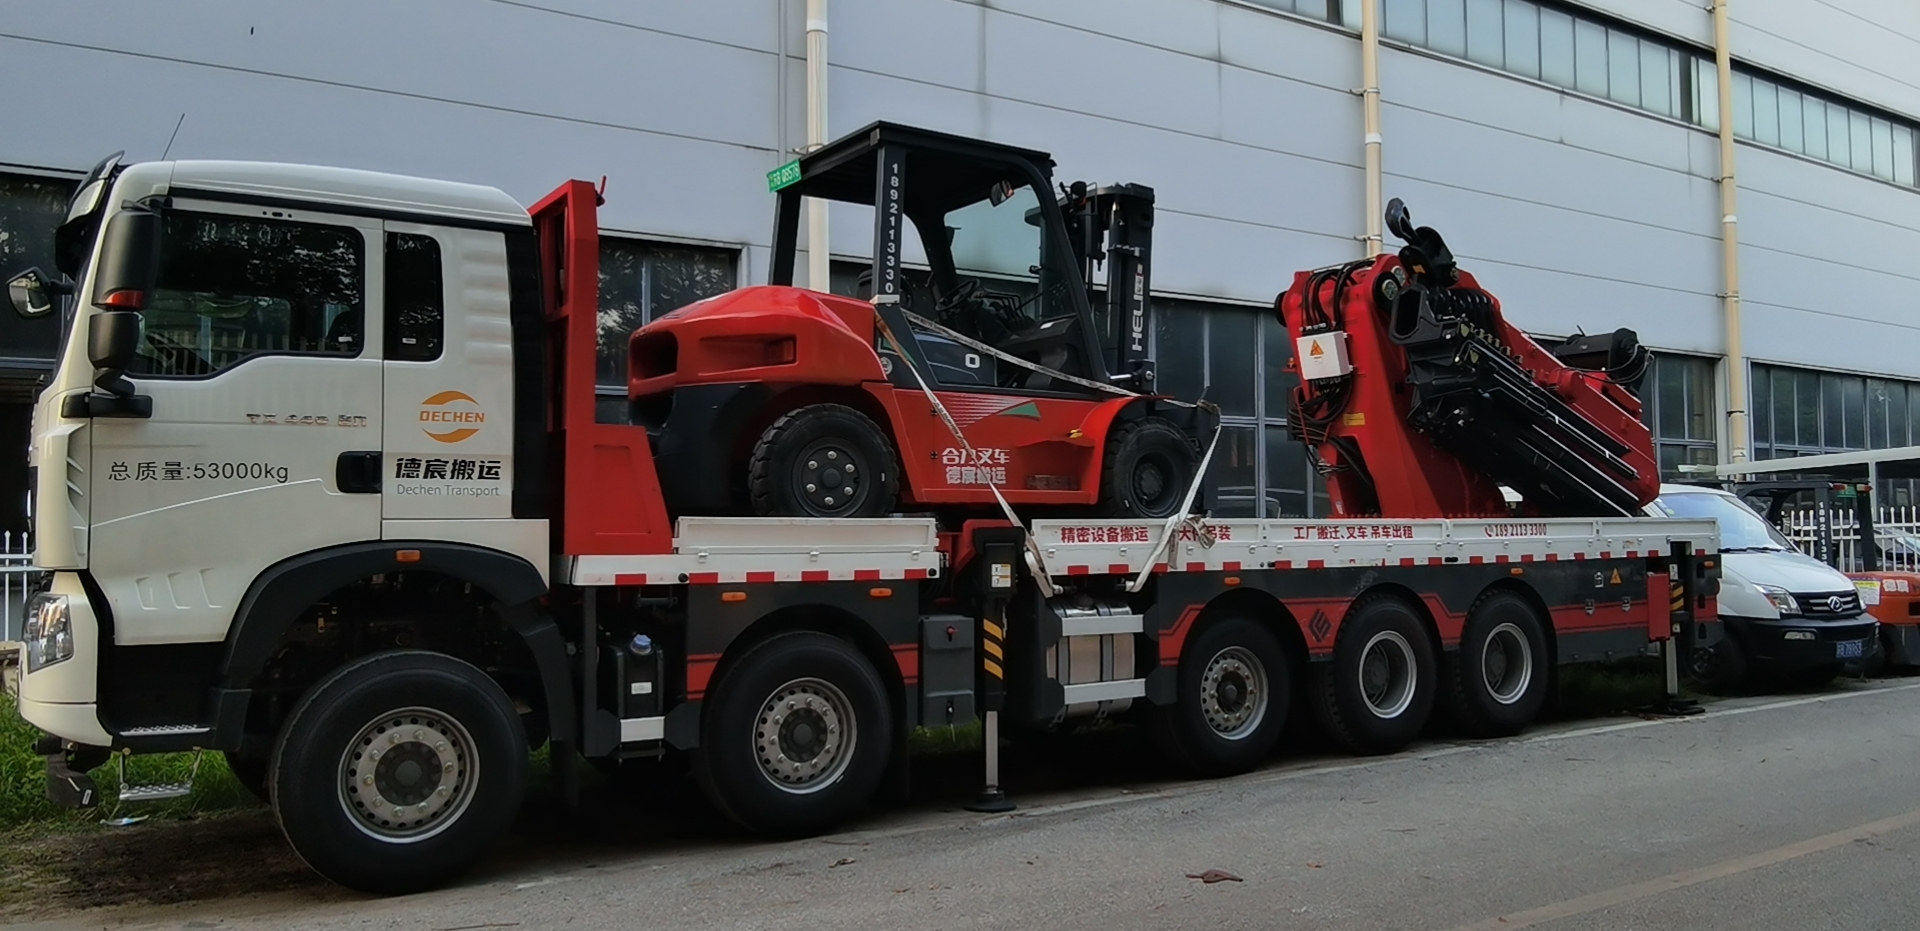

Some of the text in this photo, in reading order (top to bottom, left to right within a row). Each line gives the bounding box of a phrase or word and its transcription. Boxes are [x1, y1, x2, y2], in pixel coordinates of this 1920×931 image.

[885, 163, 899, 307] 1892113330
[1131, 294, 1144, 352] HELI
[419, 410, 486, 423] DECHEN
[108, 461, 289, 484] 总质量:53000kg
[394, 457, 502, 481] 德宸搬运
[396, 483, 500, 498] Dechen Transport
[1060, 526, 1149, 543] 精密设备搬运
